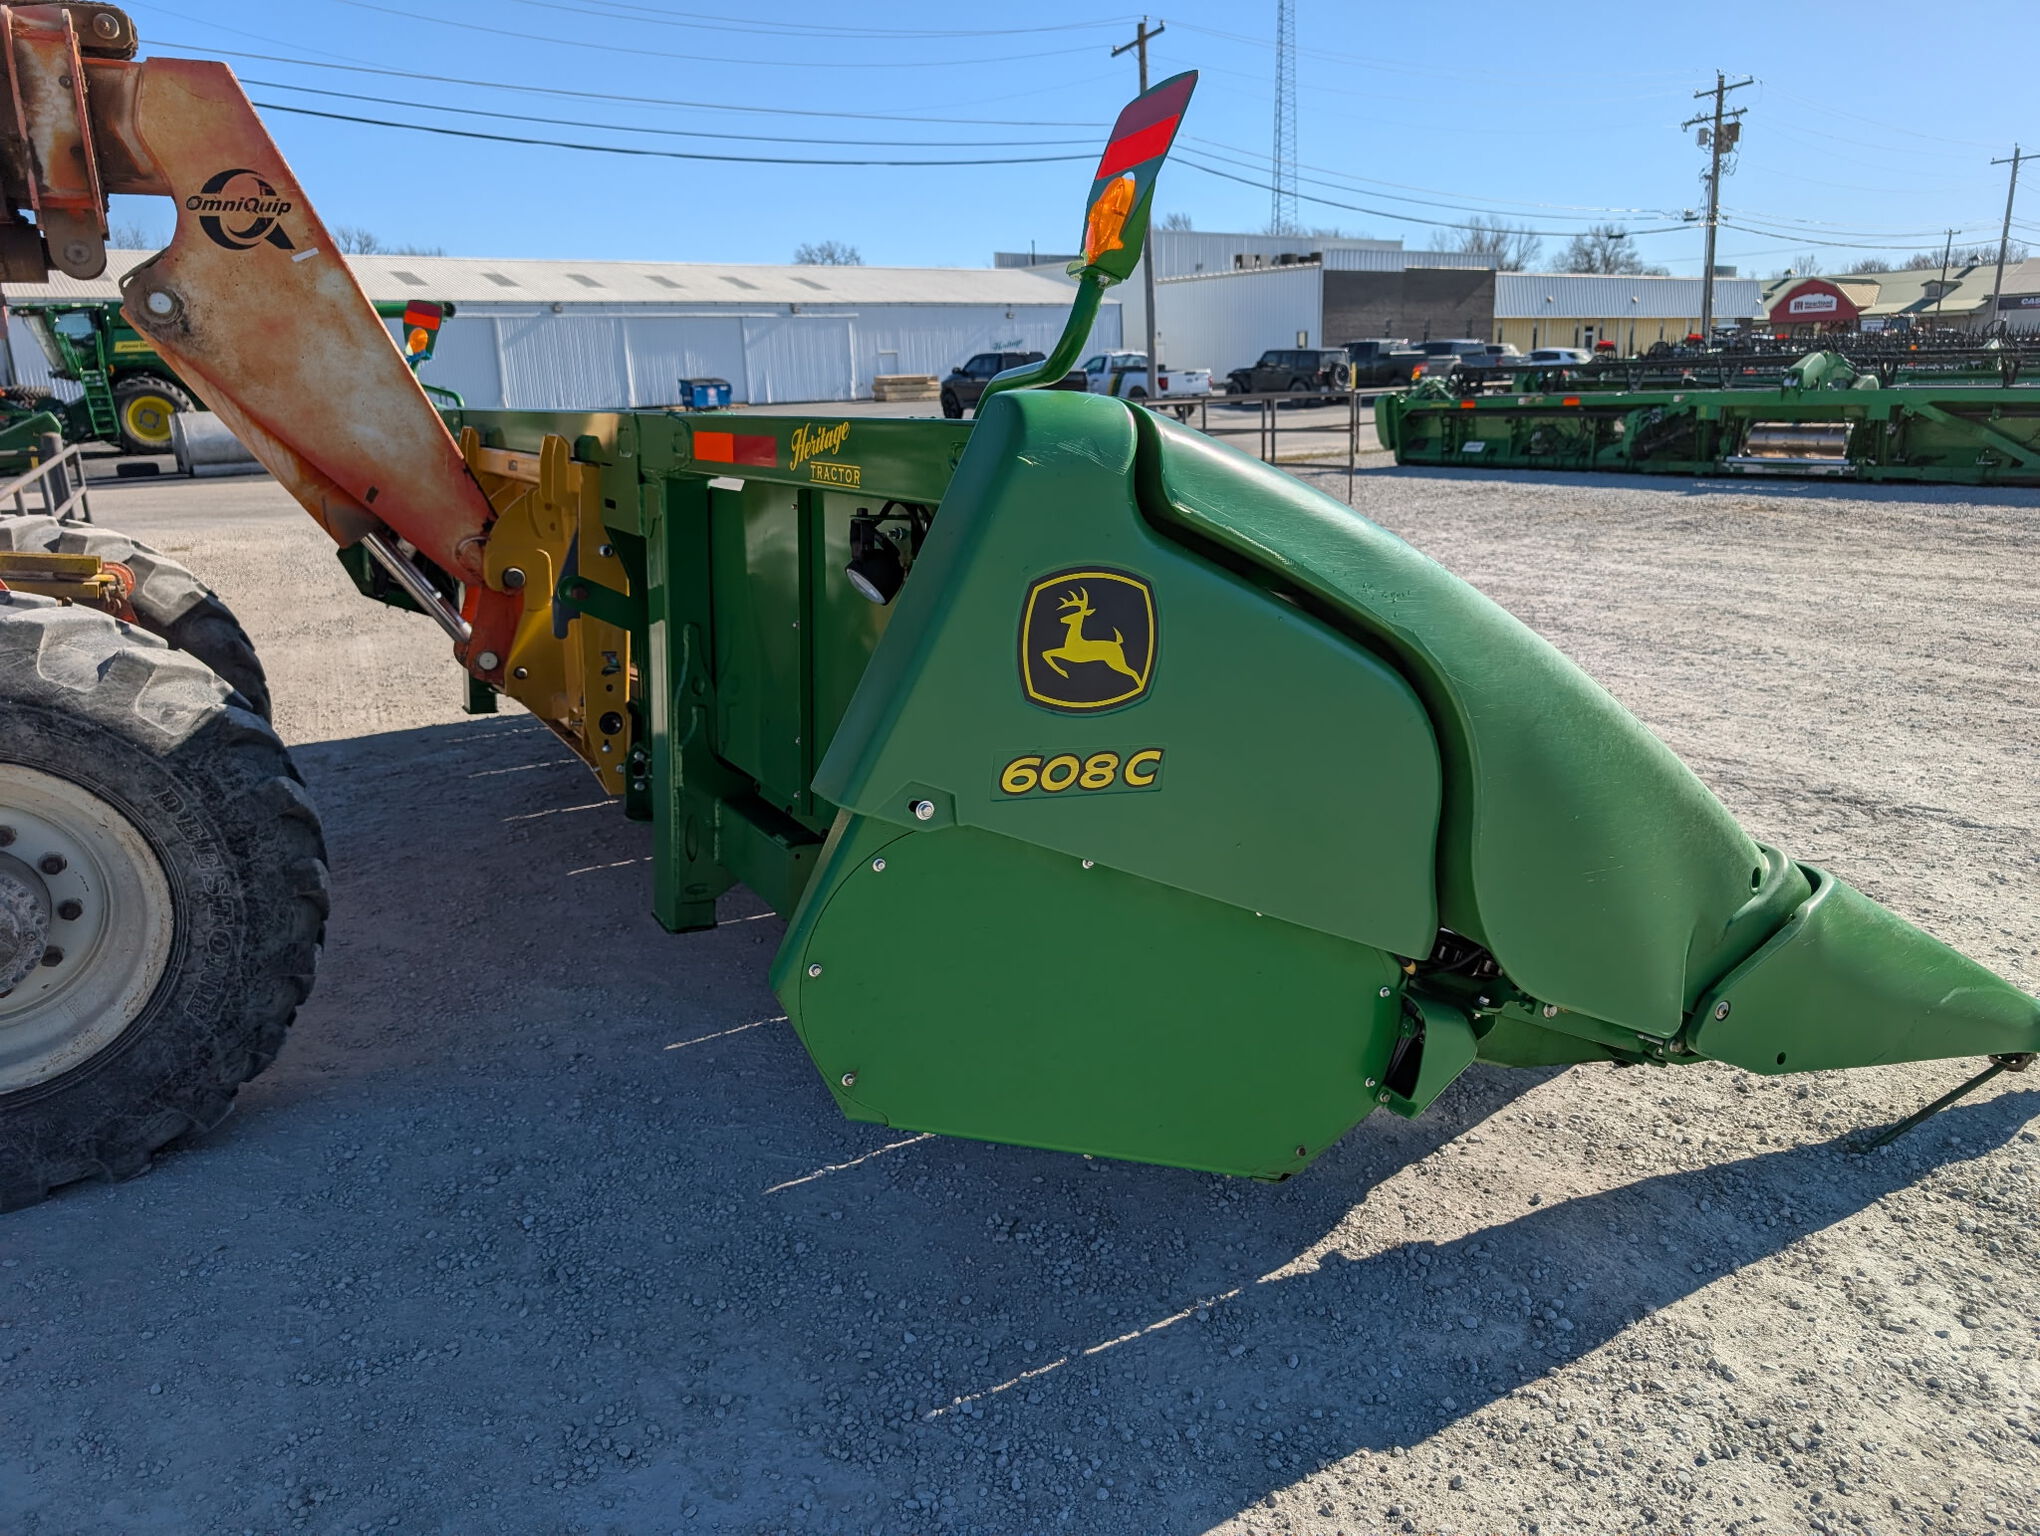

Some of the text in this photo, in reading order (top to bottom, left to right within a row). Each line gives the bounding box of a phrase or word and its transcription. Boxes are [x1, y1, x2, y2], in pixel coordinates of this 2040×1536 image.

[186, 195, 292, 216] OmniQuip
[789, 421, 850, 472] Heritage
[810, 464, 861, 485] TRACTOR
[999, 747, 1165, 795] 608C
